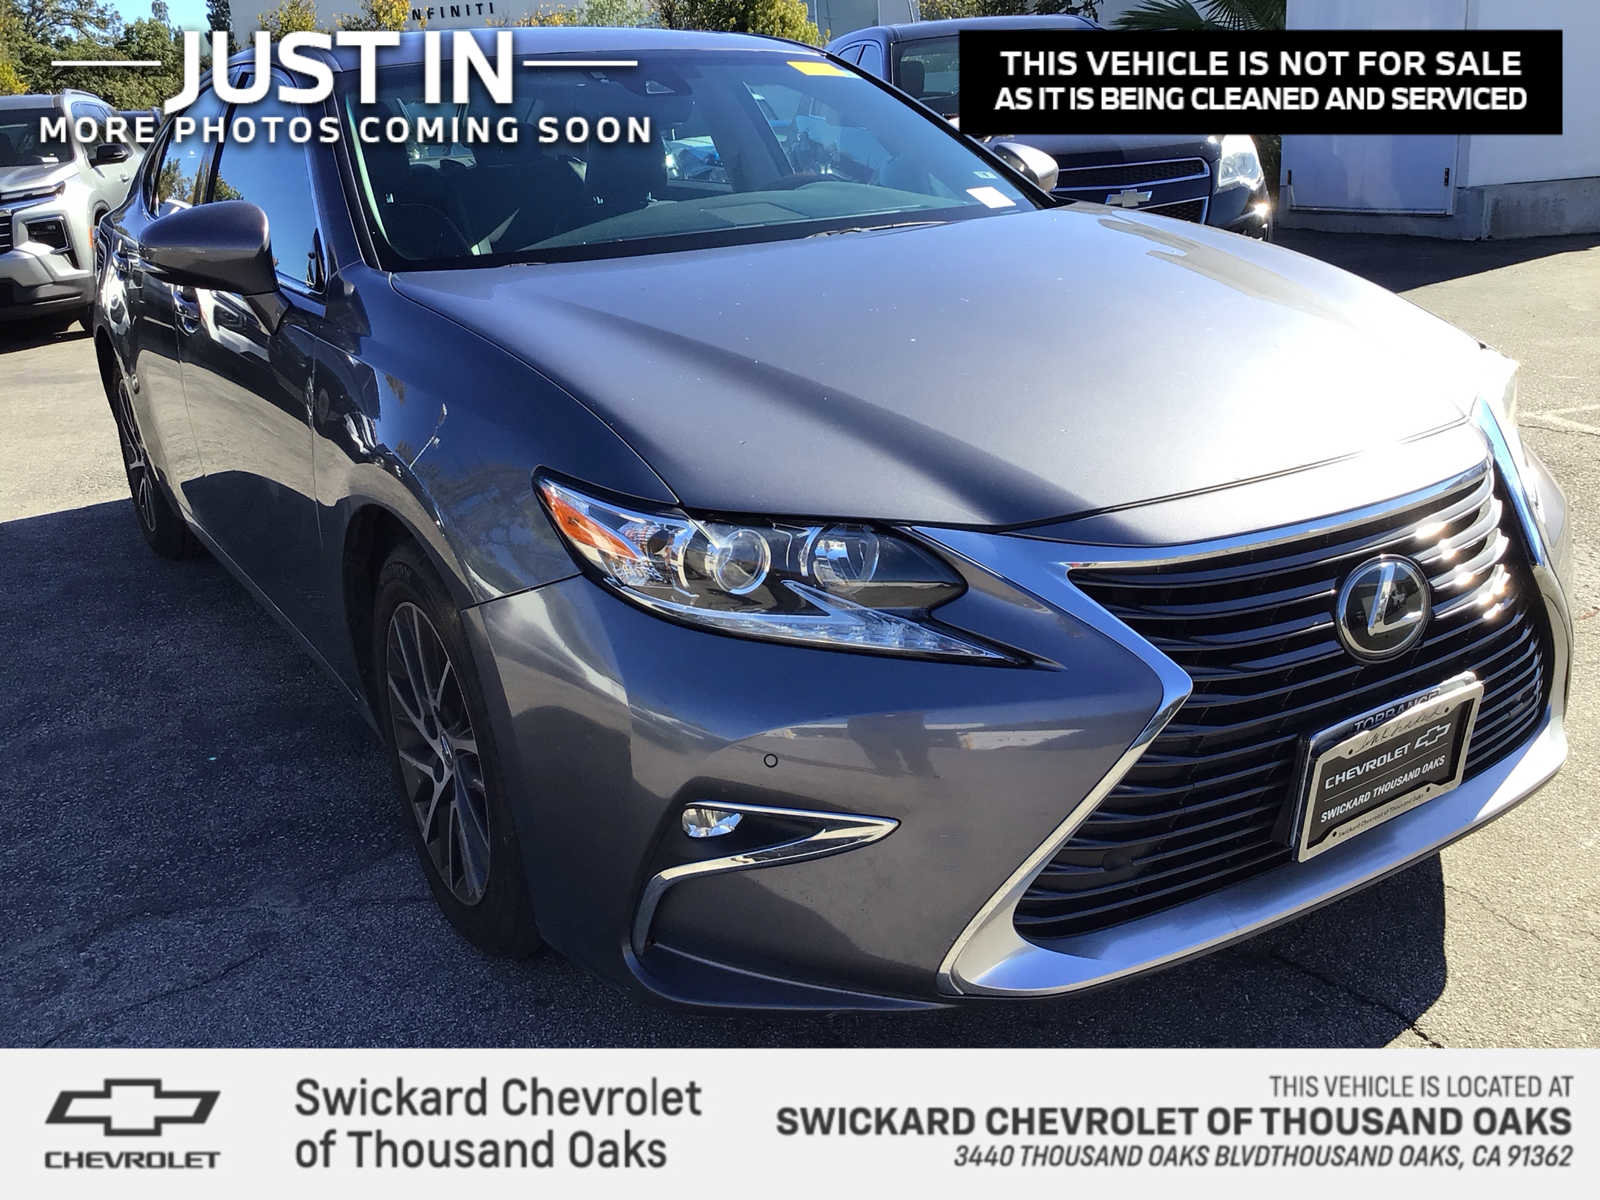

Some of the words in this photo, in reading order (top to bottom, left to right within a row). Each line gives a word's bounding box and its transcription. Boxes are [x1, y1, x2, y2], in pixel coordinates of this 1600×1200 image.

[411, 2, 494, 20] NFINITI
[1320, 791, 1371, 823] SWICKARD
[1373, 768, 1421, 798] THOUSAND
[1421, 755, 1446, 774] OAKS
[1325, 743, 1411, 790] CHEVROLET
